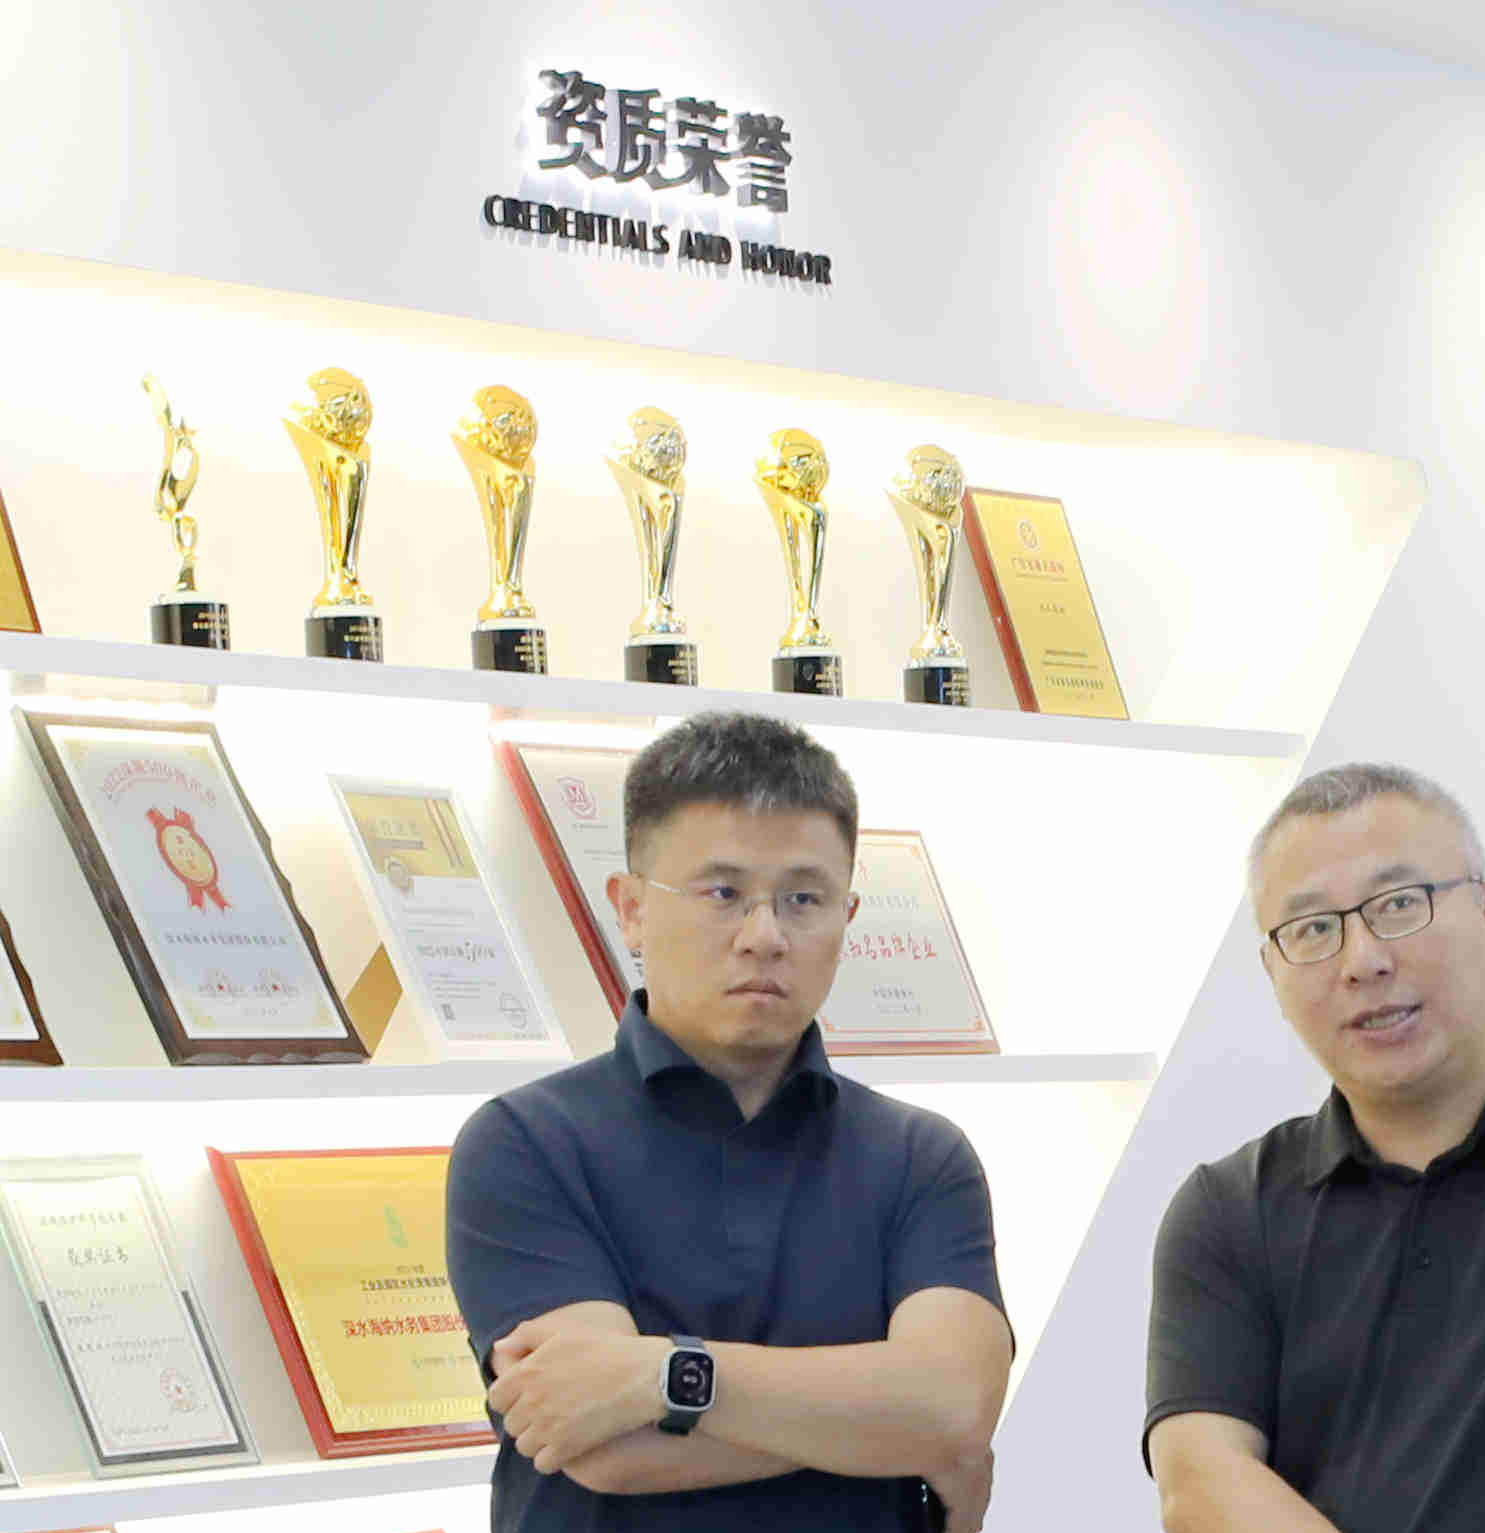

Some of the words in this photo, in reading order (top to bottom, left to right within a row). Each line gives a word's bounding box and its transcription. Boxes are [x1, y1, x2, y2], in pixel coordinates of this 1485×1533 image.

[536, 69, 792, 213] 资质荣誉
[484, 194, 670, 254] CREDENTIALS
[679, 228, 732, 265] AND
[741, 240, 832, 285] HONOR
